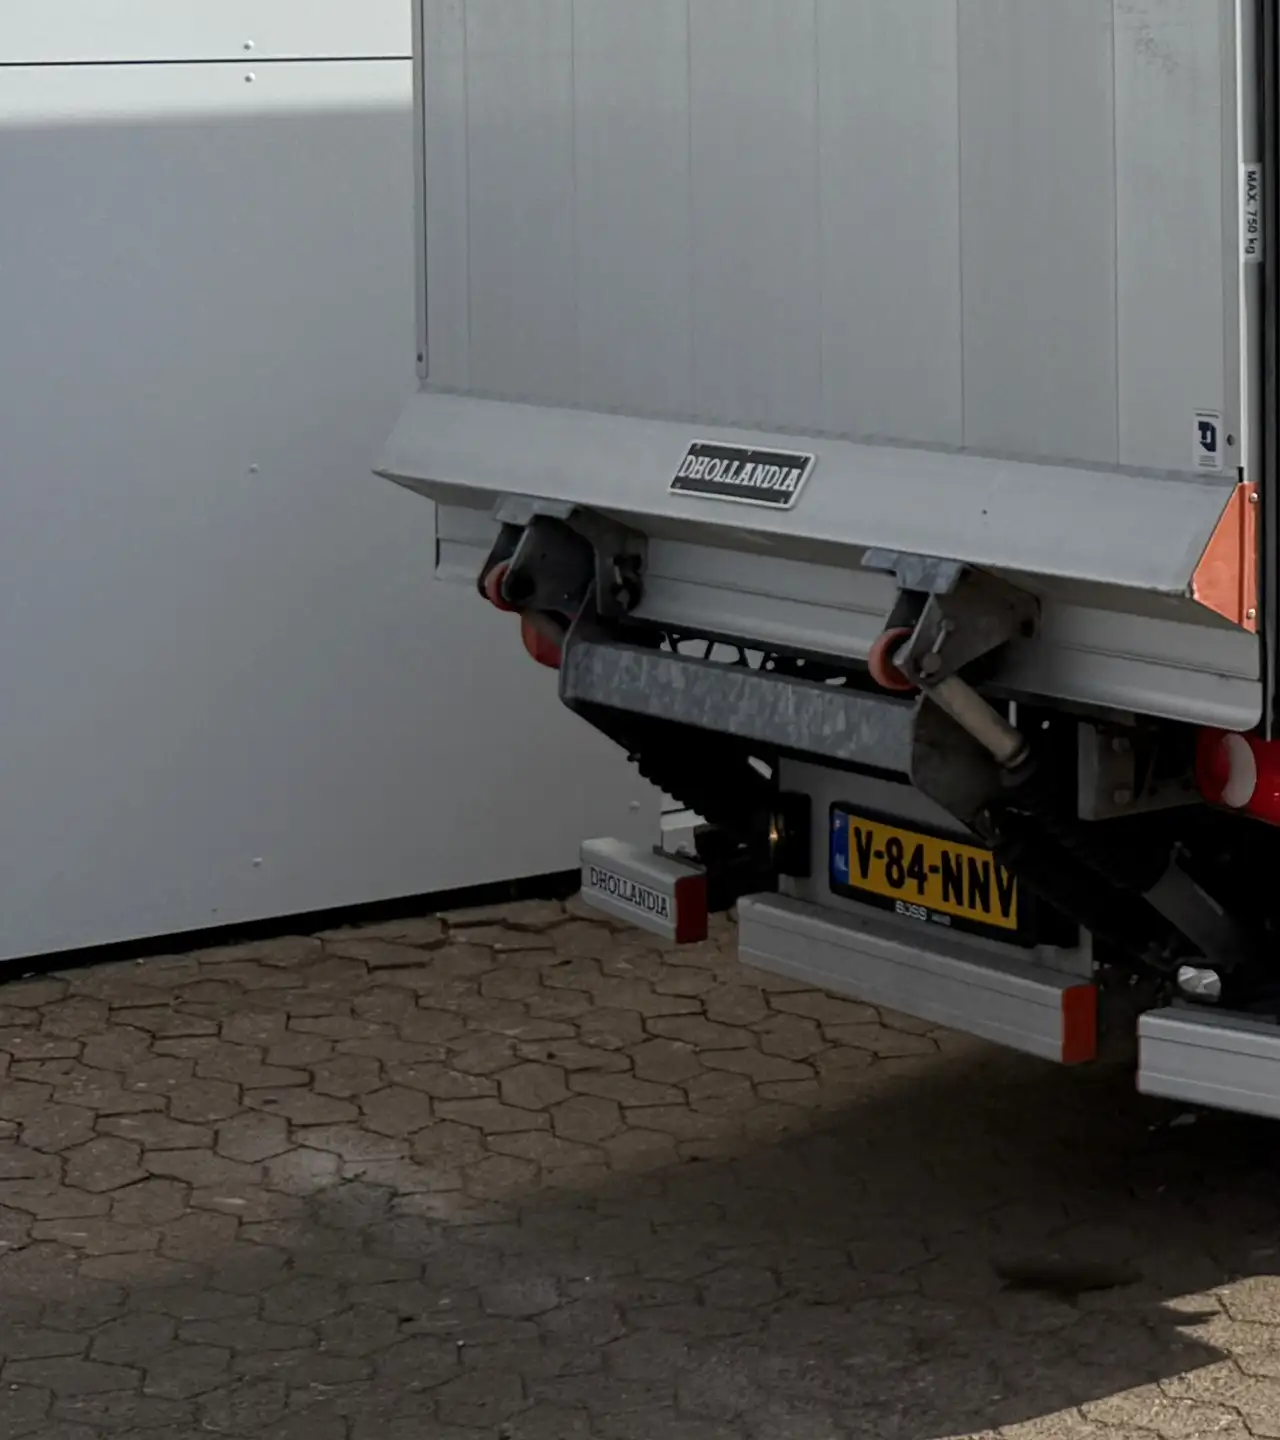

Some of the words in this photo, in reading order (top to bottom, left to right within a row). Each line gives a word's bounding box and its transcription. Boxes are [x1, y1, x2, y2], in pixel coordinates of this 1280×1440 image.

[1247, 210, 1258, 234] 750
[1245, 238, 1259, 255] kg
[678, 454, 802, 492] DHOLLANDIA
[854, 826, 1017, 917] V-84-NNV
[589, 866, 669, 918] DHOLLANDIA
